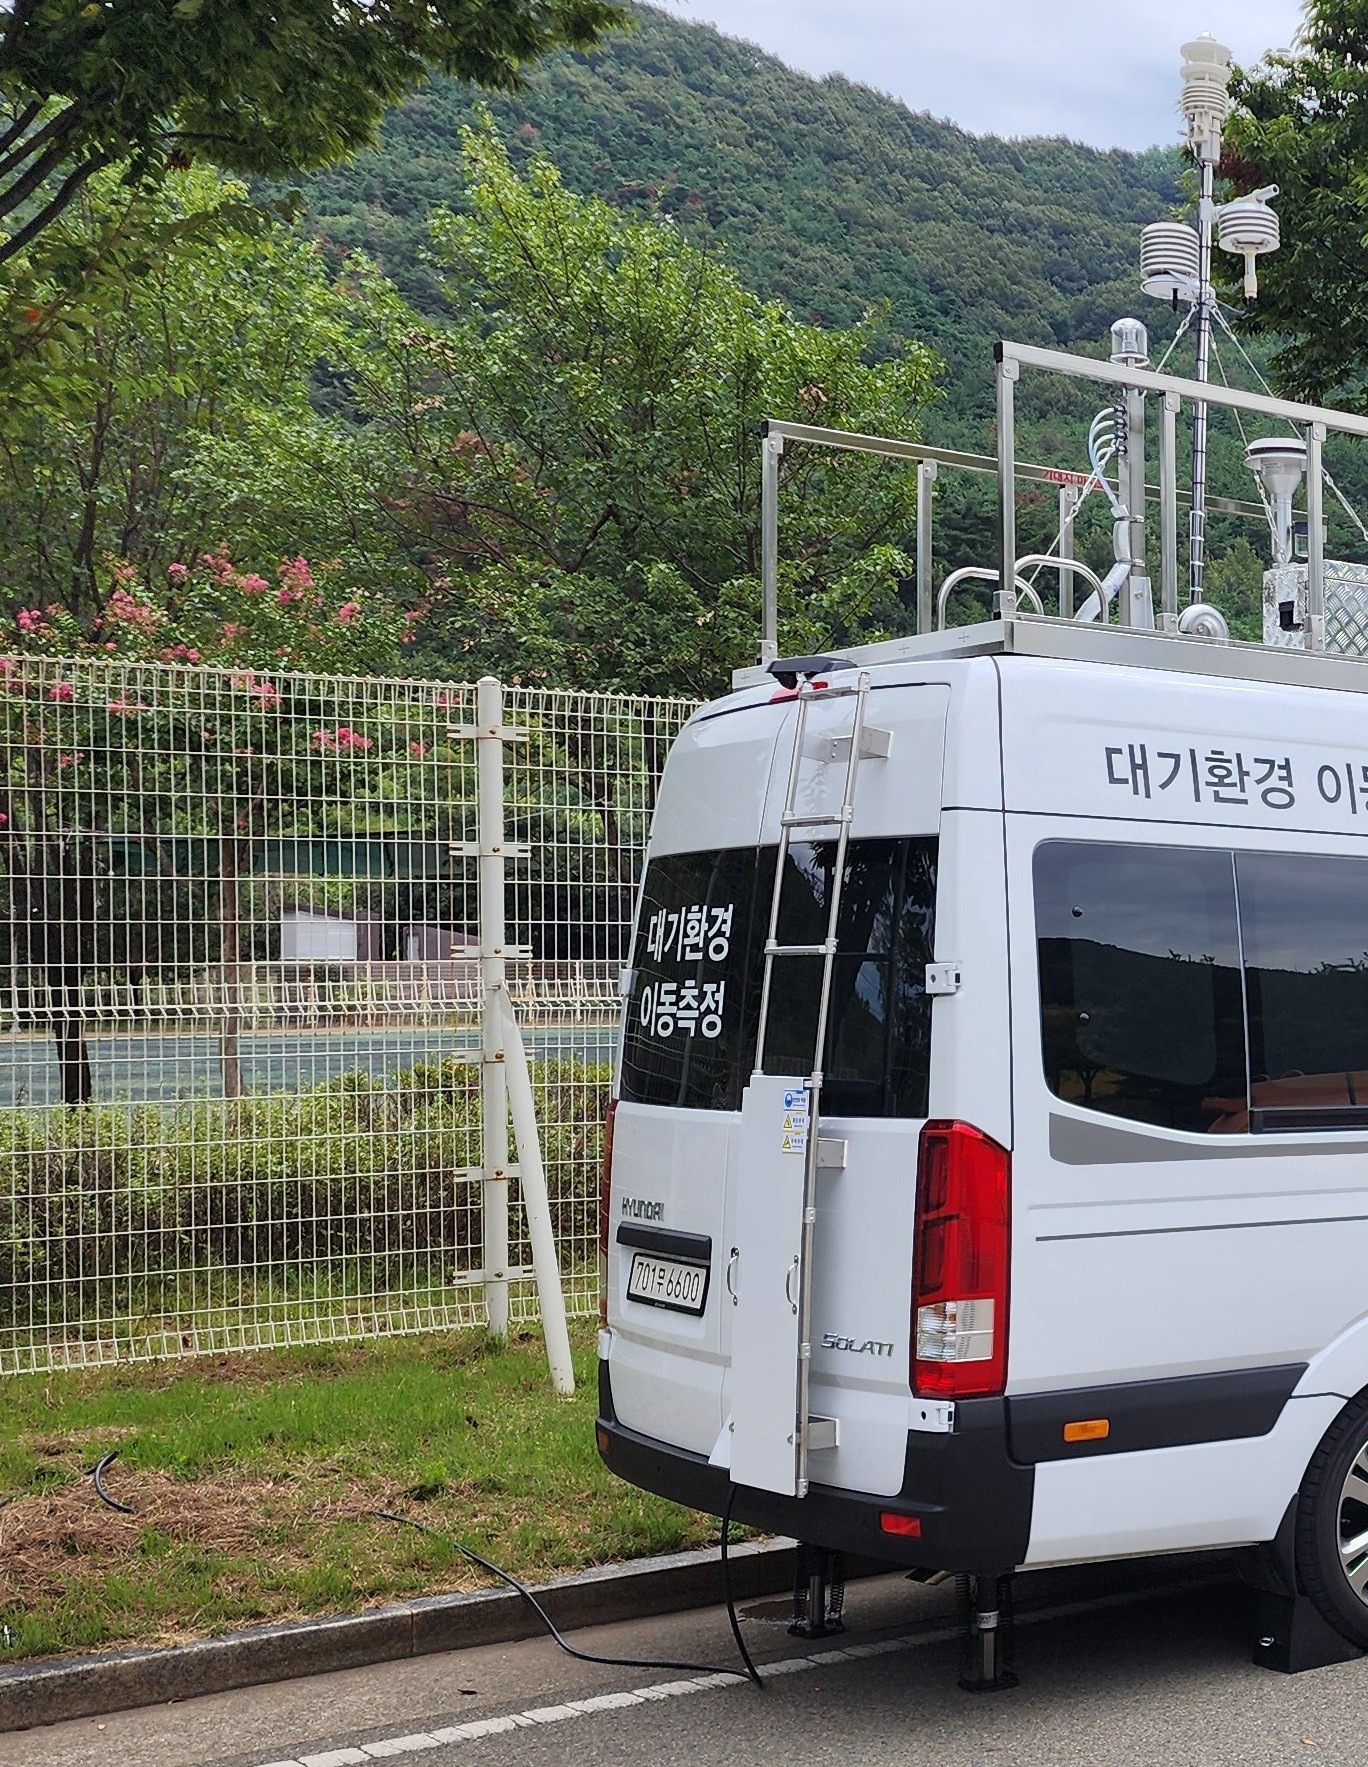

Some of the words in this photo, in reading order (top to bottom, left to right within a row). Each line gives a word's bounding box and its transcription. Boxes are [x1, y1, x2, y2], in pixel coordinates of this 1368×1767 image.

[1105, 744, 1295, 809] 대기환경
[647, 903, 734, 962] 대기환경
[640, 979, 726, 1038] 이동측정
[622, 1197, 665, 1221] HYUNDAI
[821, 1332, 895, 1357] SOLATI
